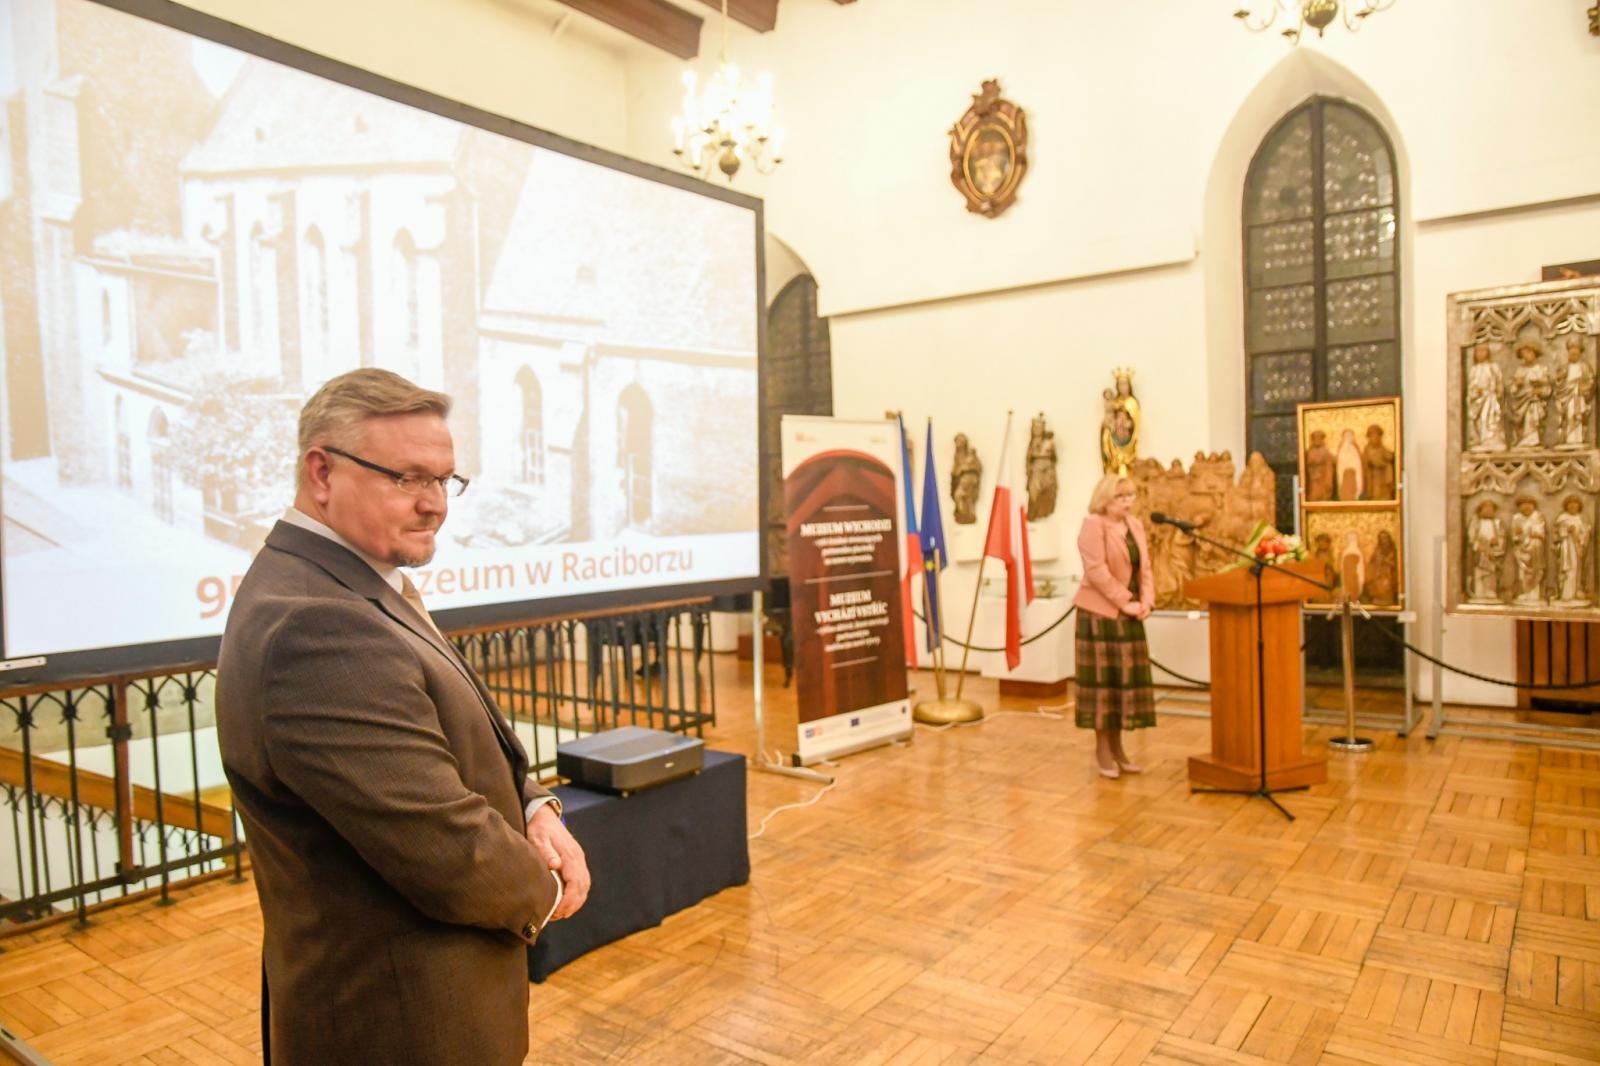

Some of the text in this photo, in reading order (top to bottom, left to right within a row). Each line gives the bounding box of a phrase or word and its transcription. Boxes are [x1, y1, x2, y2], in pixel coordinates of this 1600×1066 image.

[196, 547, 694, 619] 9 zeum w Raciborzu
